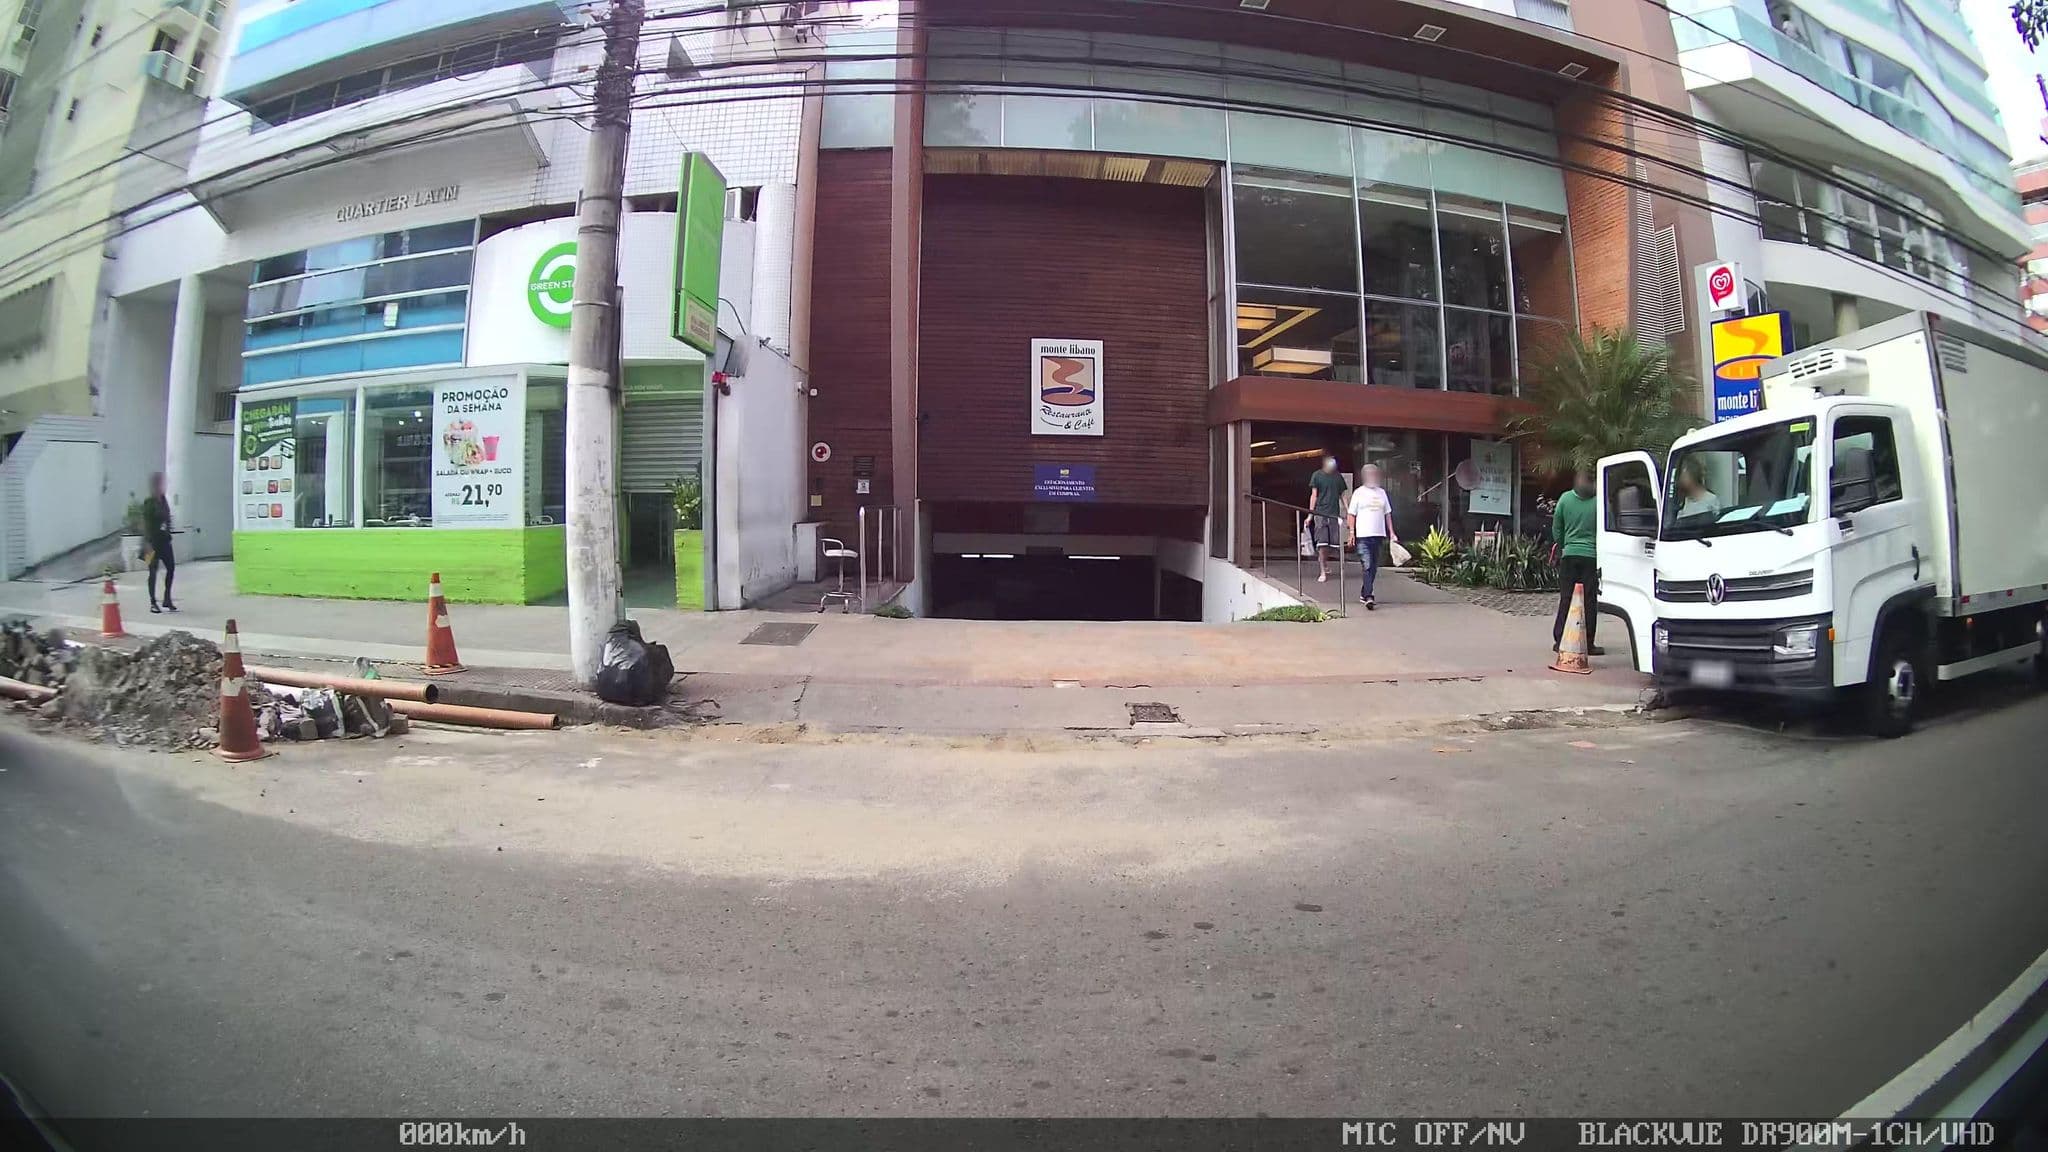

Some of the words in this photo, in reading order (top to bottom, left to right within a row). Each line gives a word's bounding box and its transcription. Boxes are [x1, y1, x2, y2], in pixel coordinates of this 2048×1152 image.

[336, 195, 410, 222] QUARTIER
[414, 184, 459, 207] LATIN
[530, 280, 561, 291] GREEN
[1040, 344, 1067, 354] monte
[441, 386, 509, 403] PROMOÇÃO
[1717, 391, 1749, 410] monte
[447, 405, 460, 414] DA
[462, 402, 502, 413] SEMANA
[1064, 421, 1072, 429] &
